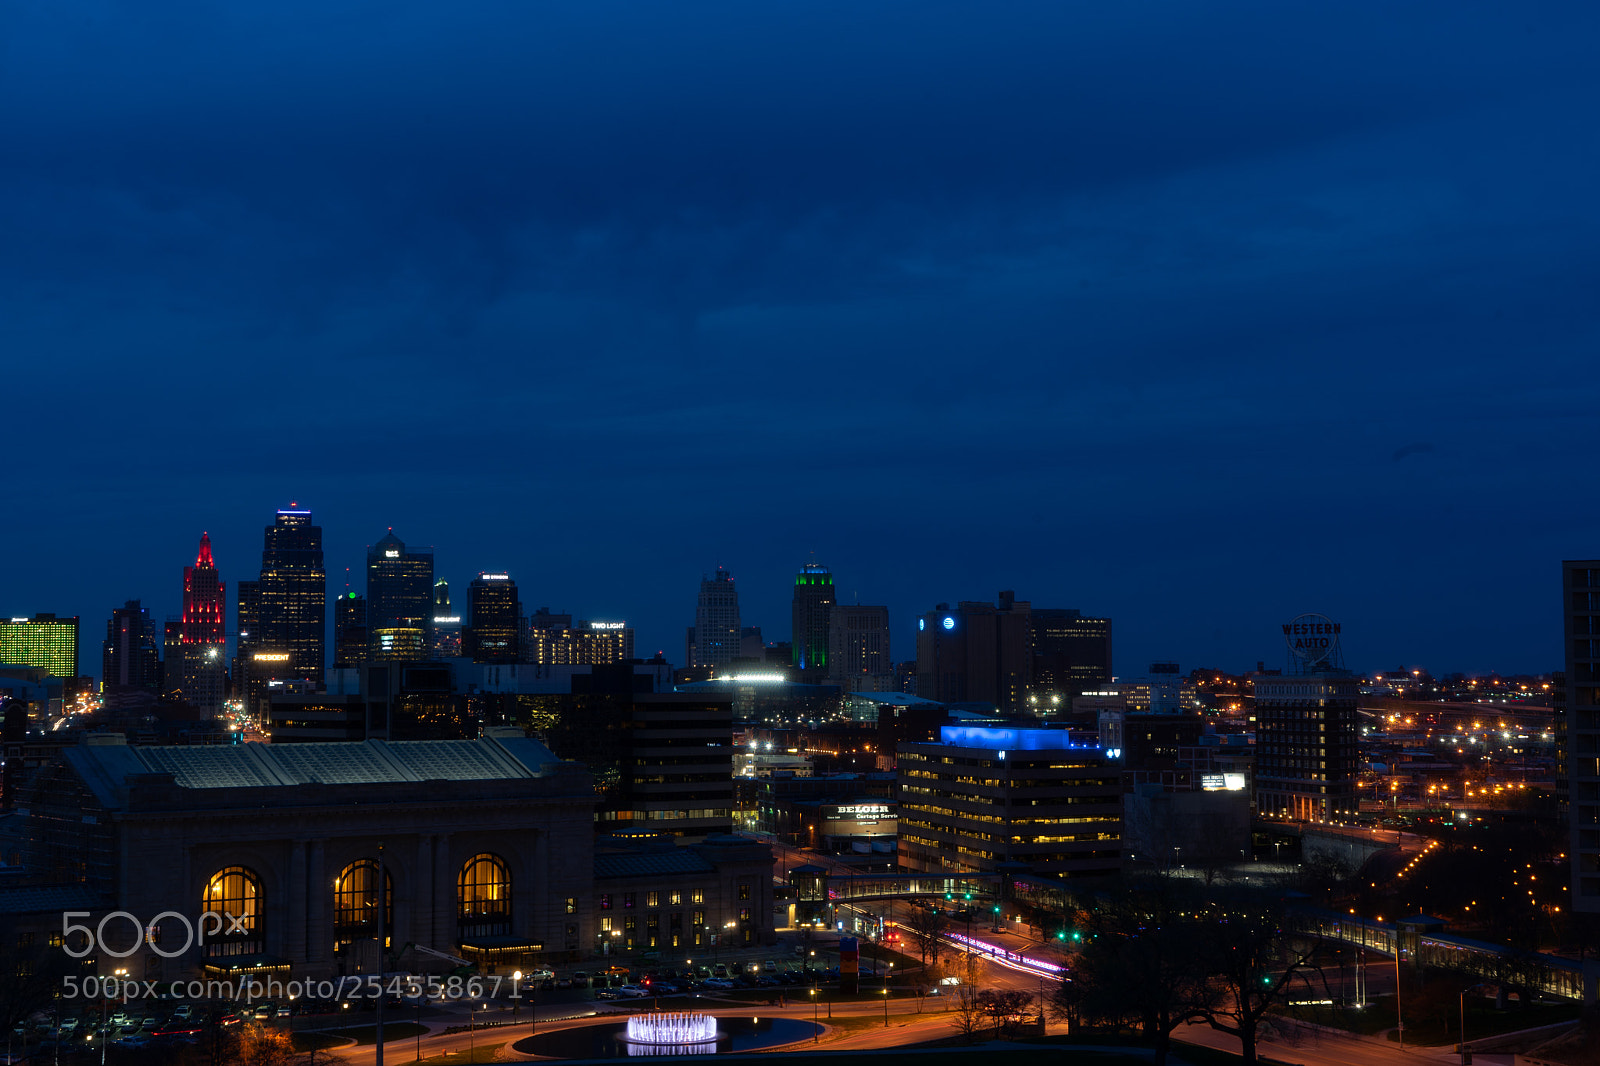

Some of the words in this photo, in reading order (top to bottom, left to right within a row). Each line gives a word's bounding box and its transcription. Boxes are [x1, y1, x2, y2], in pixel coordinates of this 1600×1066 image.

[1282, 623, 1341, 635] WESTERN
[1295, 637, 1329, 649] AUTO
[837, 805, 889, 813] BELGER
